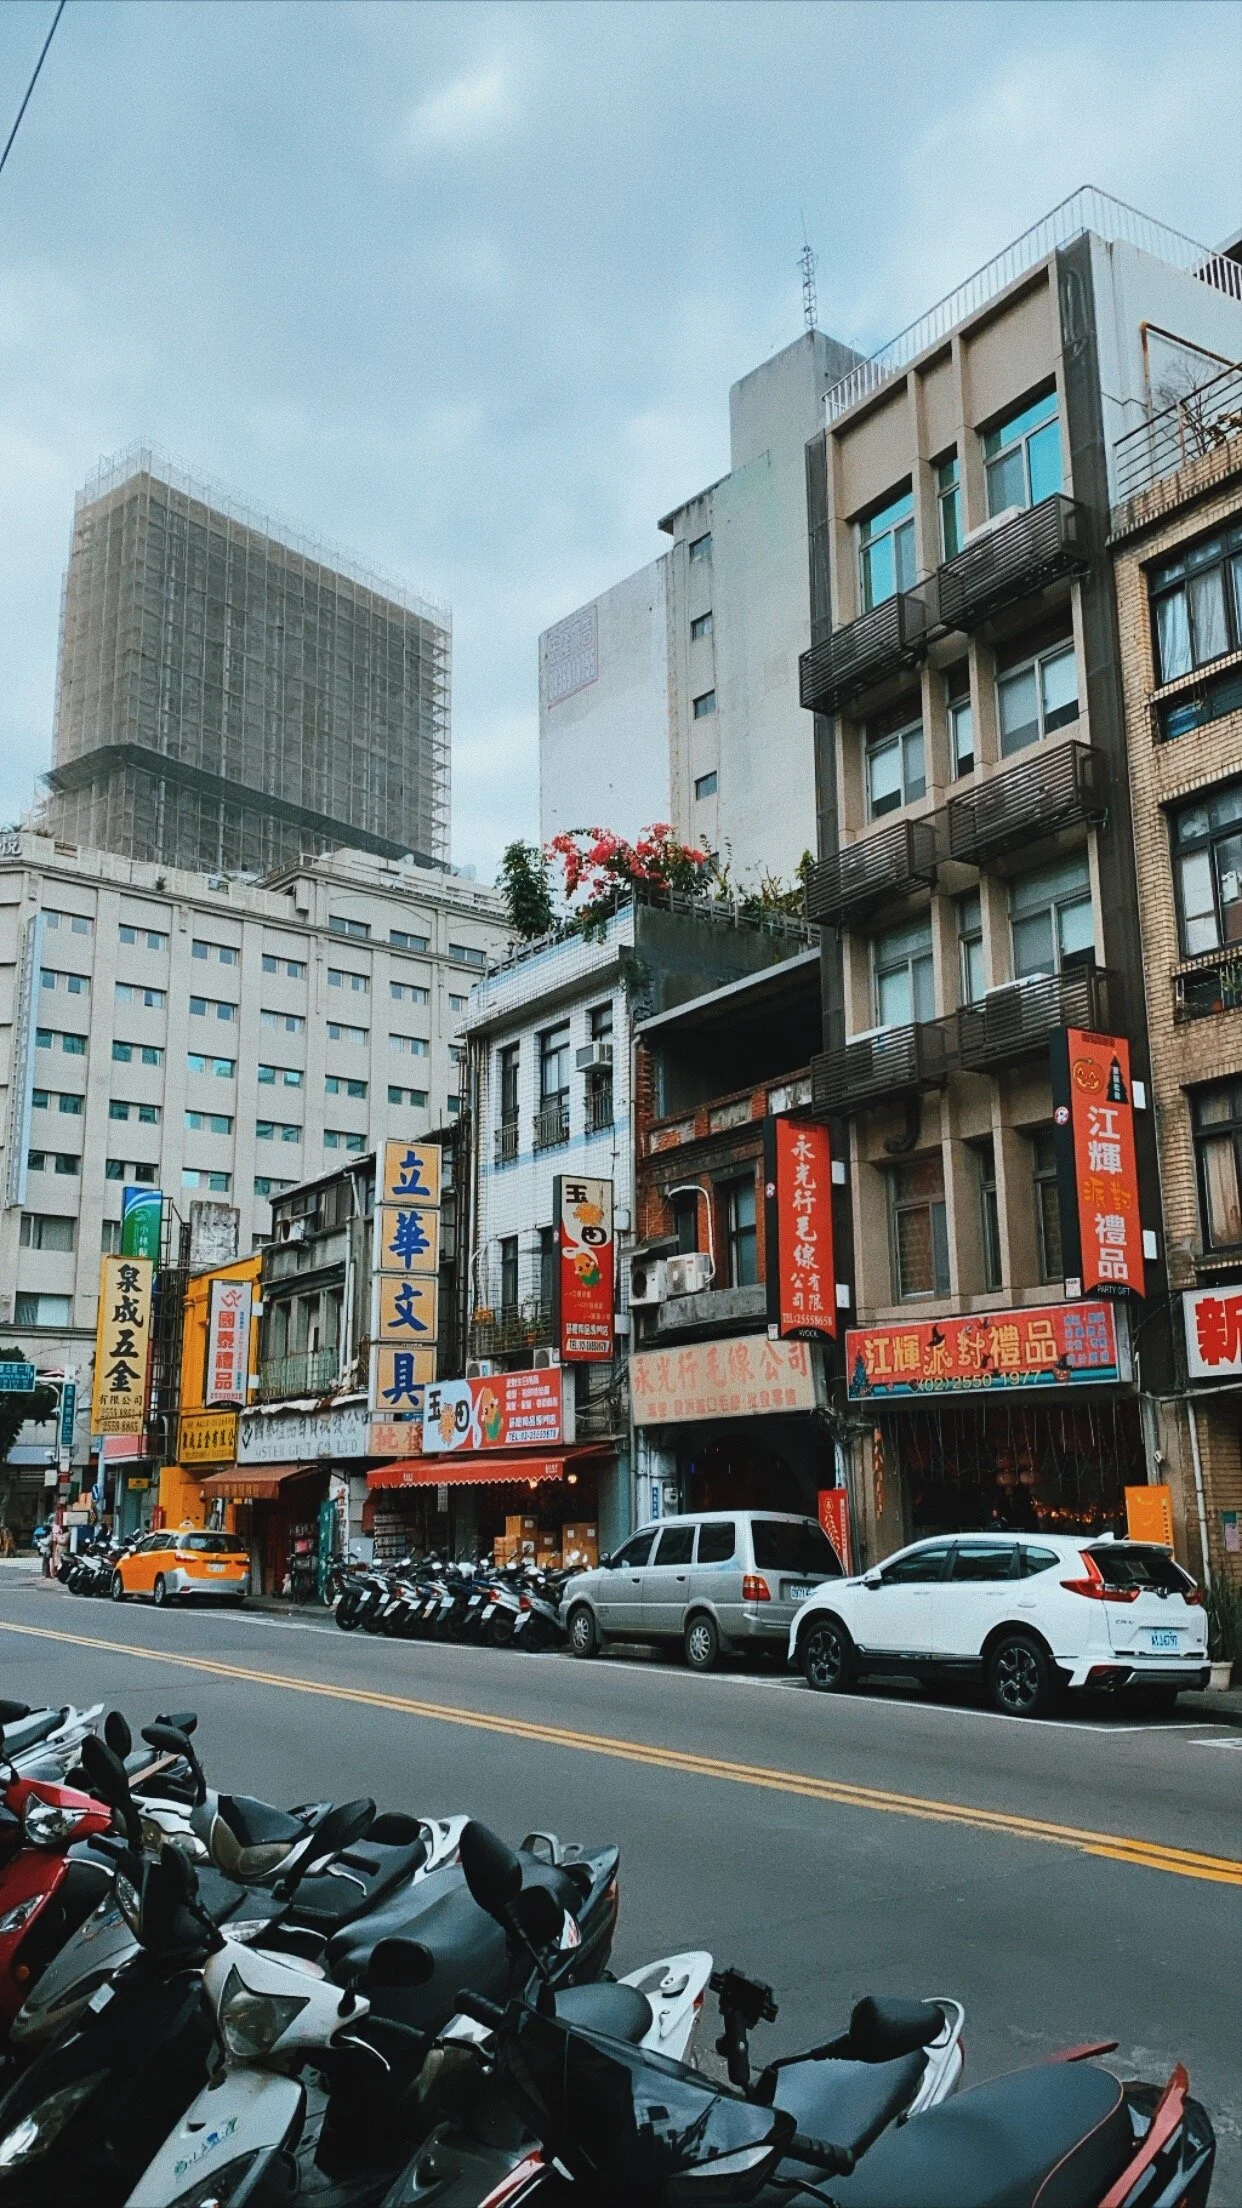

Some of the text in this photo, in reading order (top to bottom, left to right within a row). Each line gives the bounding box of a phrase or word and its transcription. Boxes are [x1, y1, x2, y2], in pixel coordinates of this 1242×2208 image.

[382, 1150, 431, 1406] 立華文具
[1097, 1285, 1116, 1295] PARTY
[104, 1263, 144, 1393] 泉成五金
[864, 1319, 1059, 1376] 江輝派對禮品
[99, 1394, 142, 1406] 有限公司
[917, 1370, 1042, 1393] (02)2550-1977
